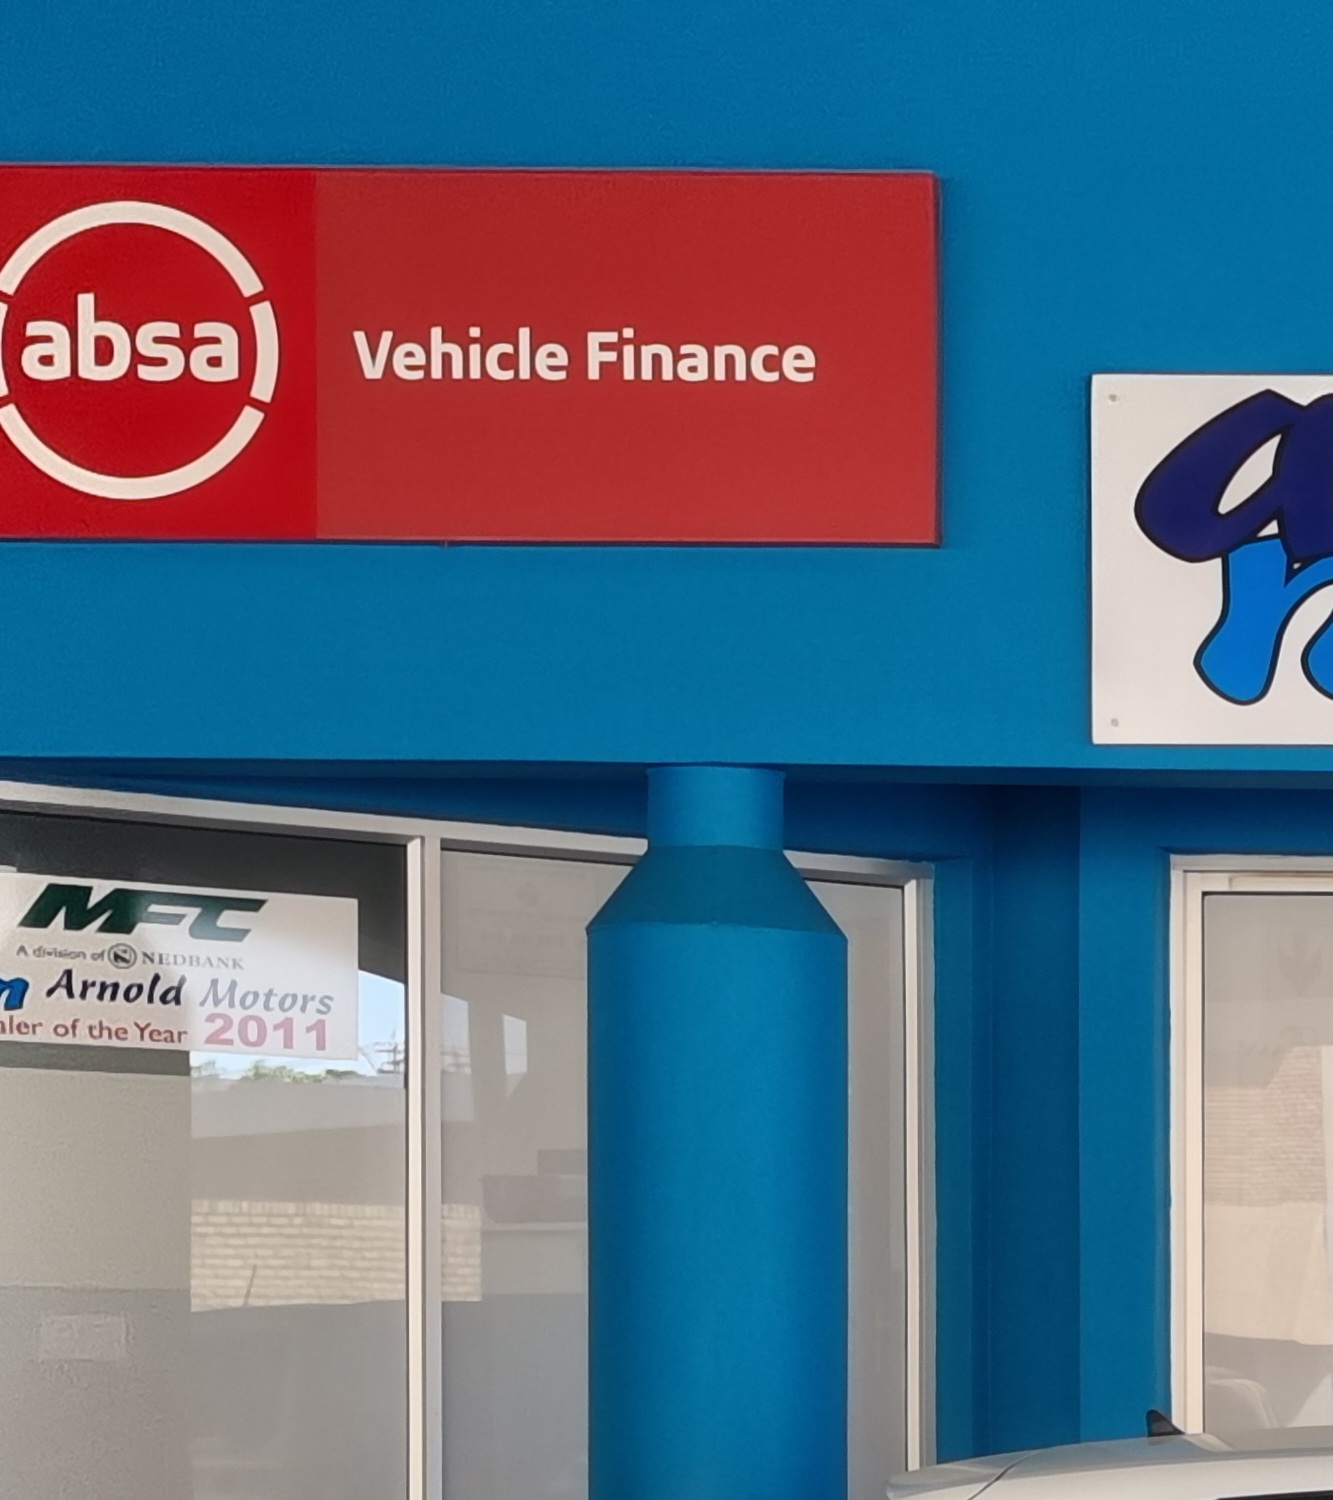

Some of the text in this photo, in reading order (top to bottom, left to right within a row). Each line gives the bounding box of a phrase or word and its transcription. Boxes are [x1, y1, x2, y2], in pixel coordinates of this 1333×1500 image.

[21, 292, 240, 383] absa
[353, 327, 816, 383] Vehicle Finance
[18, 882, 268, 942] MFC
[16, 945, 244, 970] A division of NEDBANK
[46, 968, 188, 1006] Arnold
[199, 978, 335, 1015] Motors
[53, 1018, 80, 1039] of
[88, 1019, 128, 1041] the
[133, 1021, 188, 1044] Year
[204, 1013, 328, 1051] 2011
